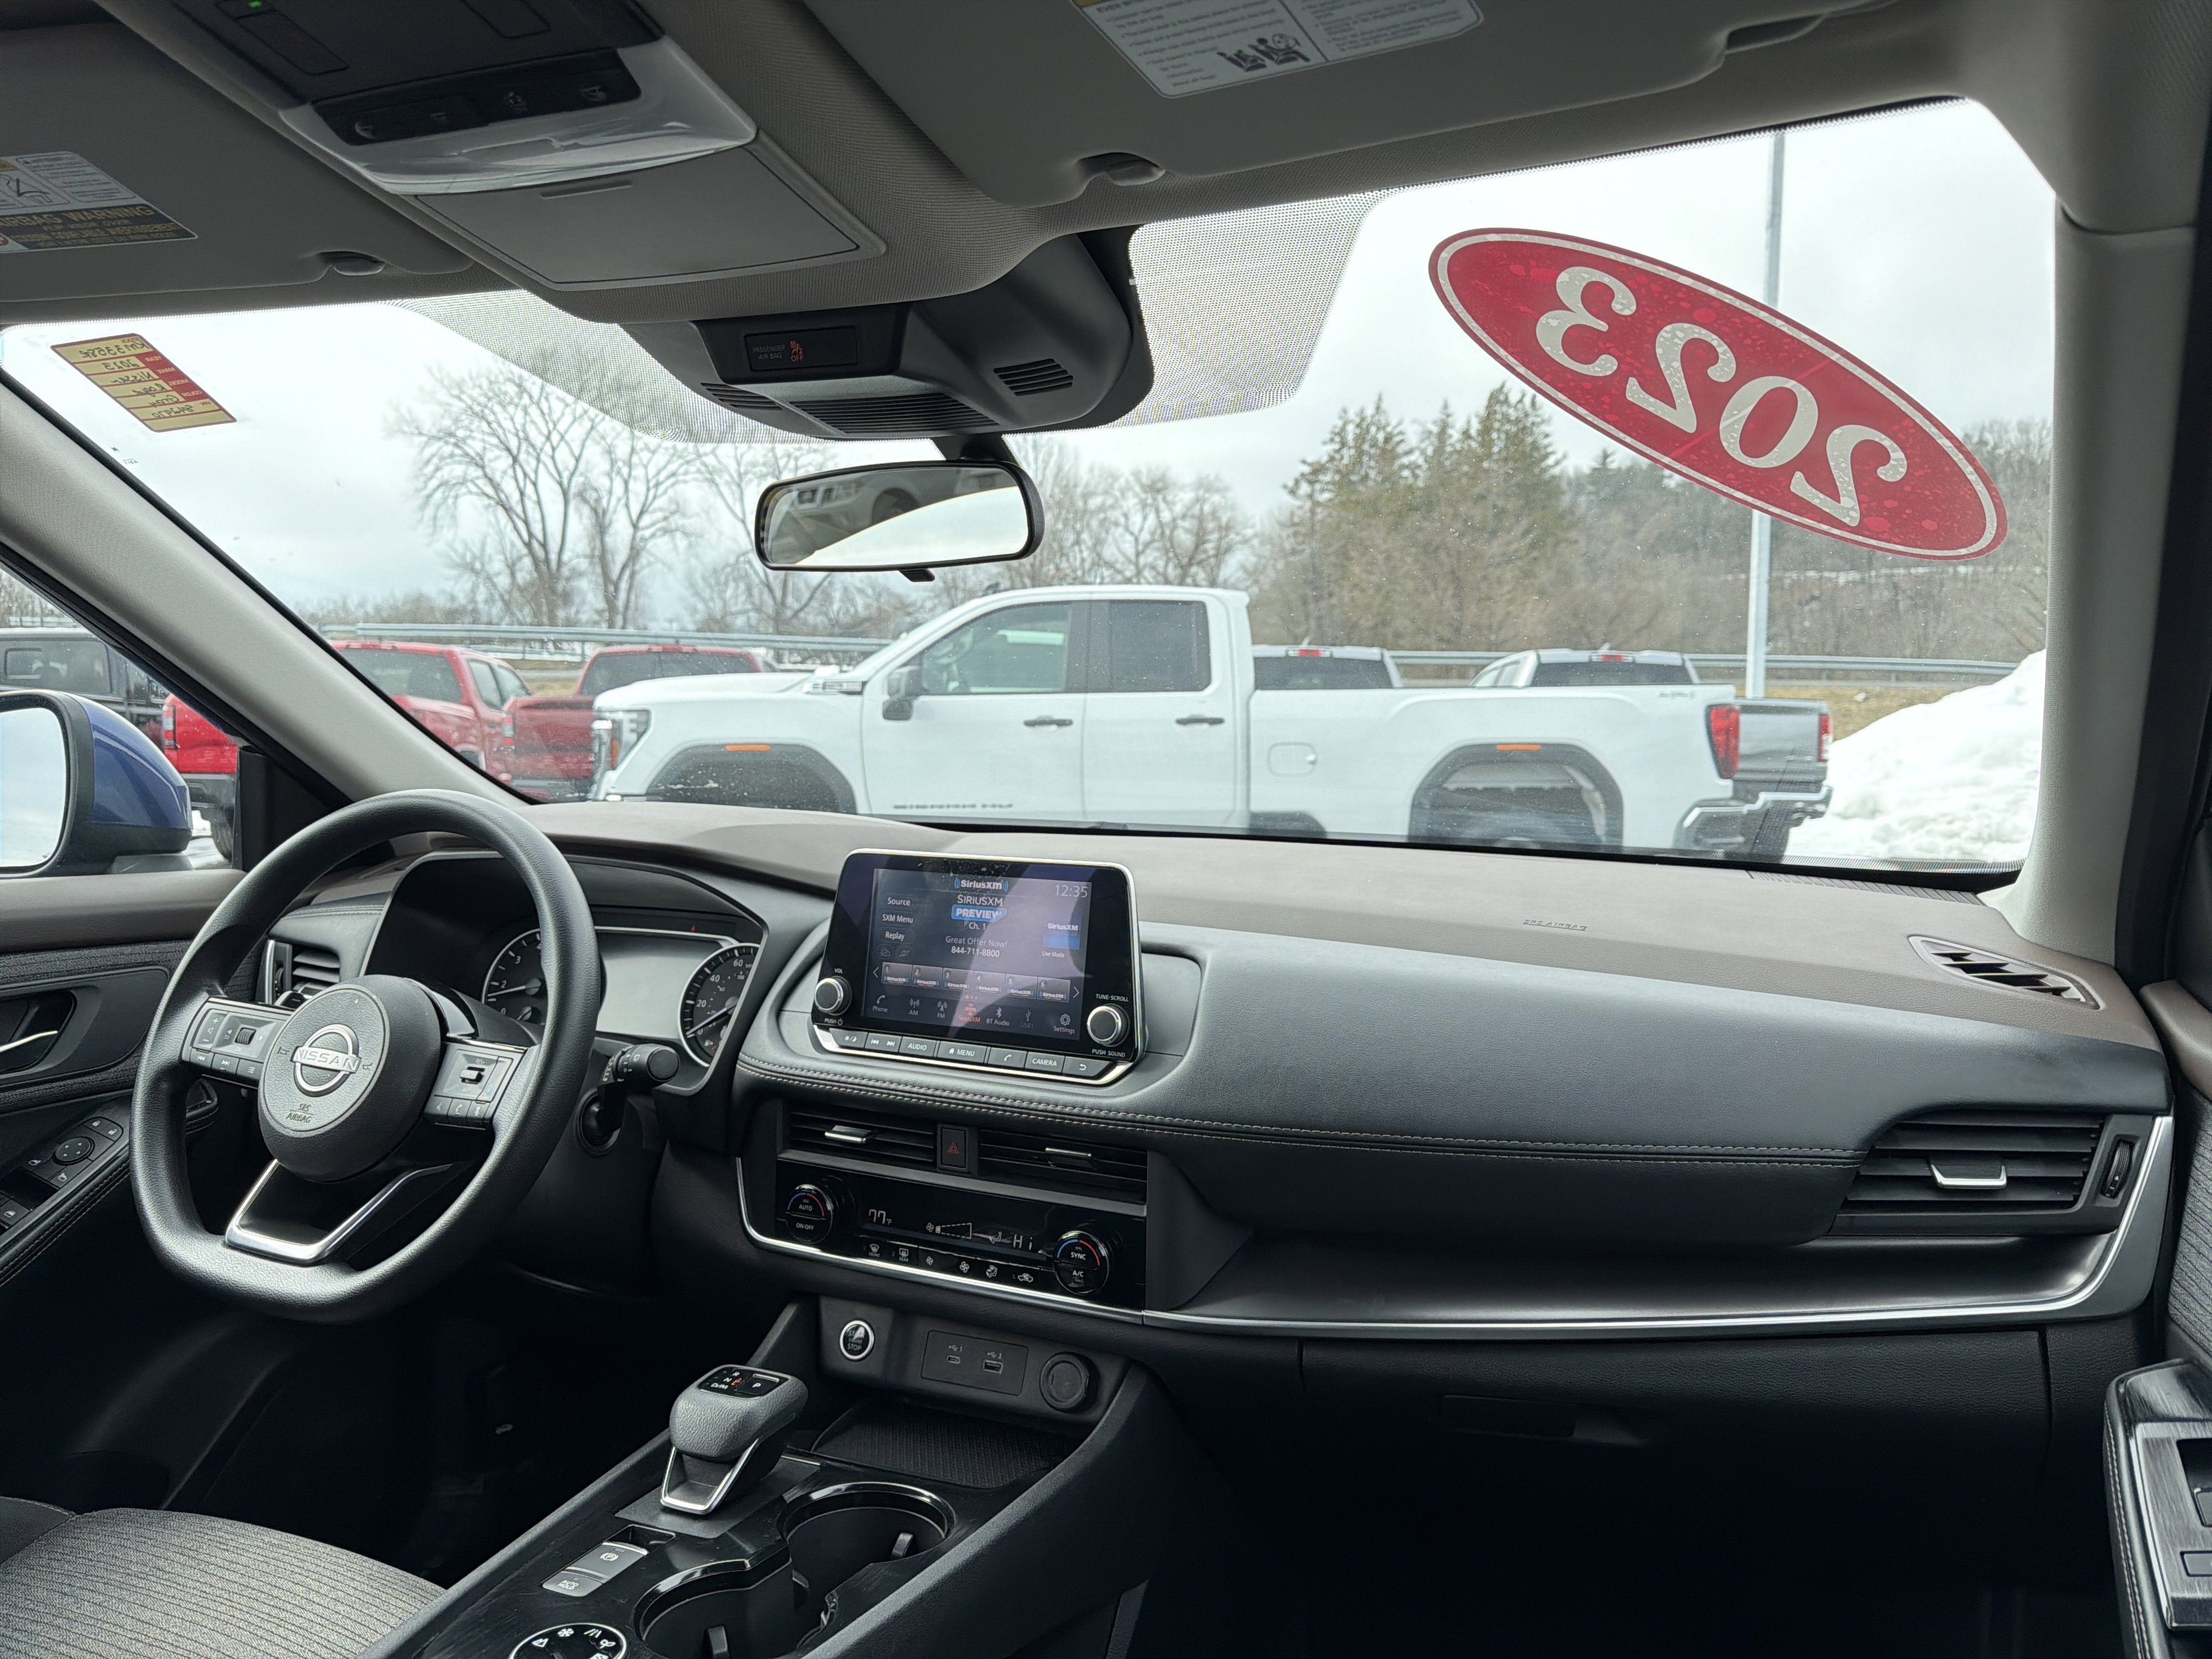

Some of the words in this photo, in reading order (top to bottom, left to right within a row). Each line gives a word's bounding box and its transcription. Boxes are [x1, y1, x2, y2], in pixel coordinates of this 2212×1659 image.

[0, 215, 61, 228] IRBAG
[62, 206, 154, 221] WARNING
[1056, 884, 1088, 898] 12:35
[887, 897, 911, 906] Source
[956, 907, 1002, 919] PREVIEW
[882, 913, 895, 922] SXM
[896, 915, 913, 924] Menu
[969, 922, 980, 930] Ch.
[885, 932, 905, 941] Replay
[945, 936, 966, 944] Great
[967, 937, 987, 946] Offer
[989, 939, 1008, 948] Now!
[951, 946, 1000, 957] 844-711-8800
[515, 956, 521, 964] 3
[1053, 1026, 1075, 1034] Settings
[957, 1048, 975, 1057] MENU
[294, 1048, 359, 1070] NISSAN
[1032, 1058, 1057, 1067] CAMERA
[298, 1103, 312, 1111] SRS
[286, 1113, 312, 1123] AIRBAG
[1071, 1252, 1086, 1260] SYNC
